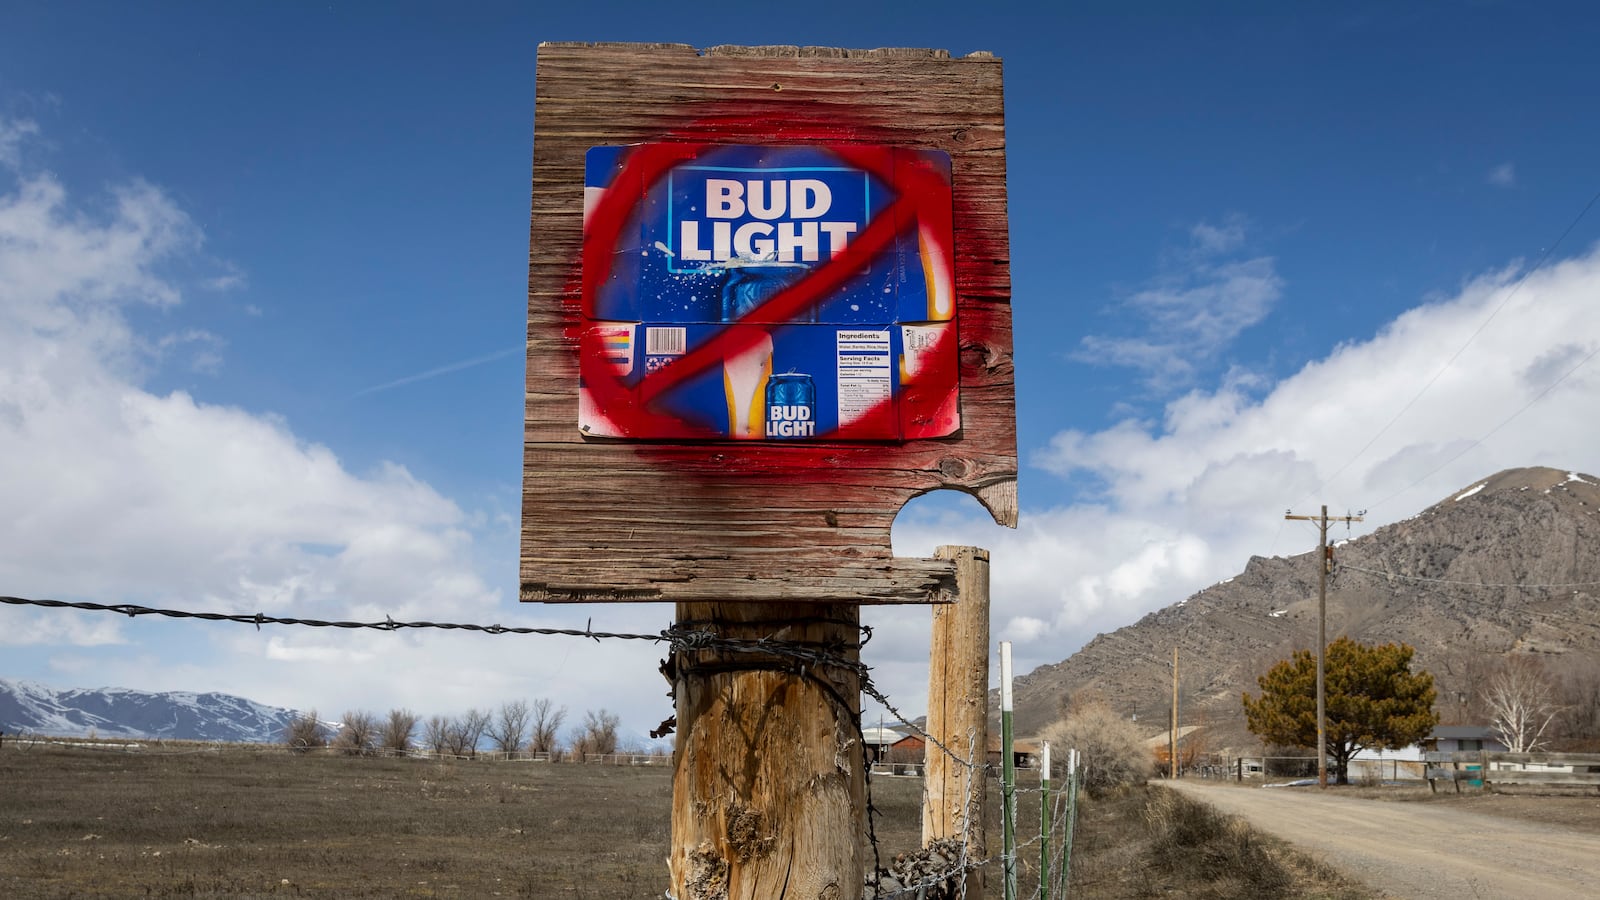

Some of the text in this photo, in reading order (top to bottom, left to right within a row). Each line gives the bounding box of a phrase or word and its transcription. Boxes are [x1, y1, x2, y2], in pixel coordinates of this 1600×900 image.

[706, 179, 832, 220] BUD
[681, 220, 857, 262] LIGHT
[839, 332, 880, 340] Ingredients
[771, 405, 810, 420] BUD
[766, 421, 815, 437] LIGHT
